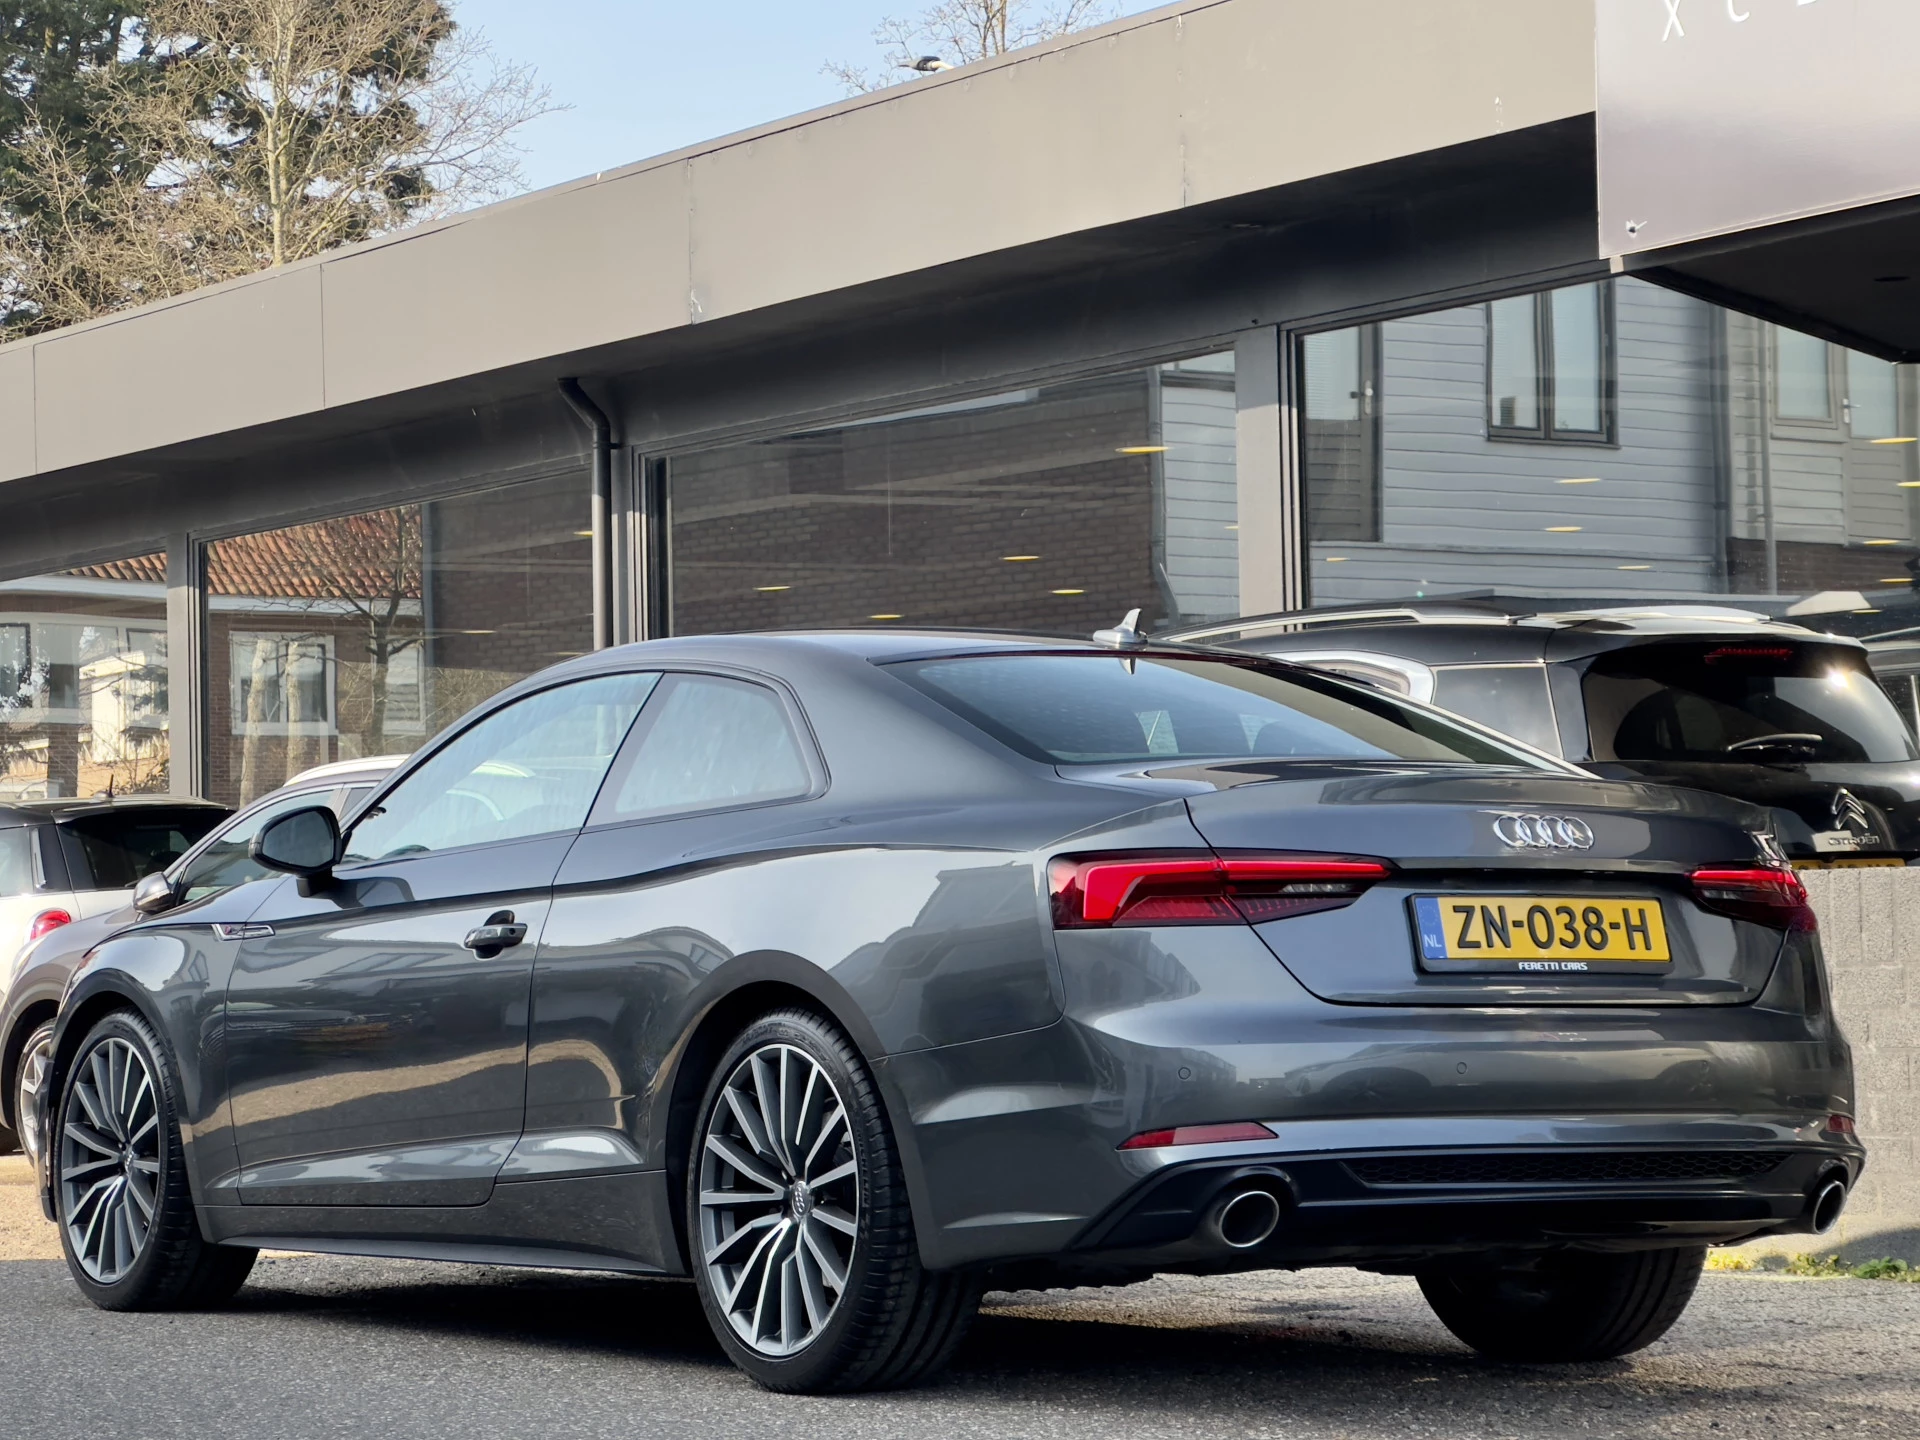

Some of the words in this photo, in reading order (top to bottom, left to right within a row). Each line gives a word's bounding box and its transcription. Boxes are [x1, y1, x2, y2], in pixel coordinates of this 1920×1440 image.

[1452, 904, 1652, 951] ZN-038-H
[1424, 933, 1443, 948] NL
[1518, 961, 1560, 971] FERETTI
[1561, 961, 1588, 971] CARS
